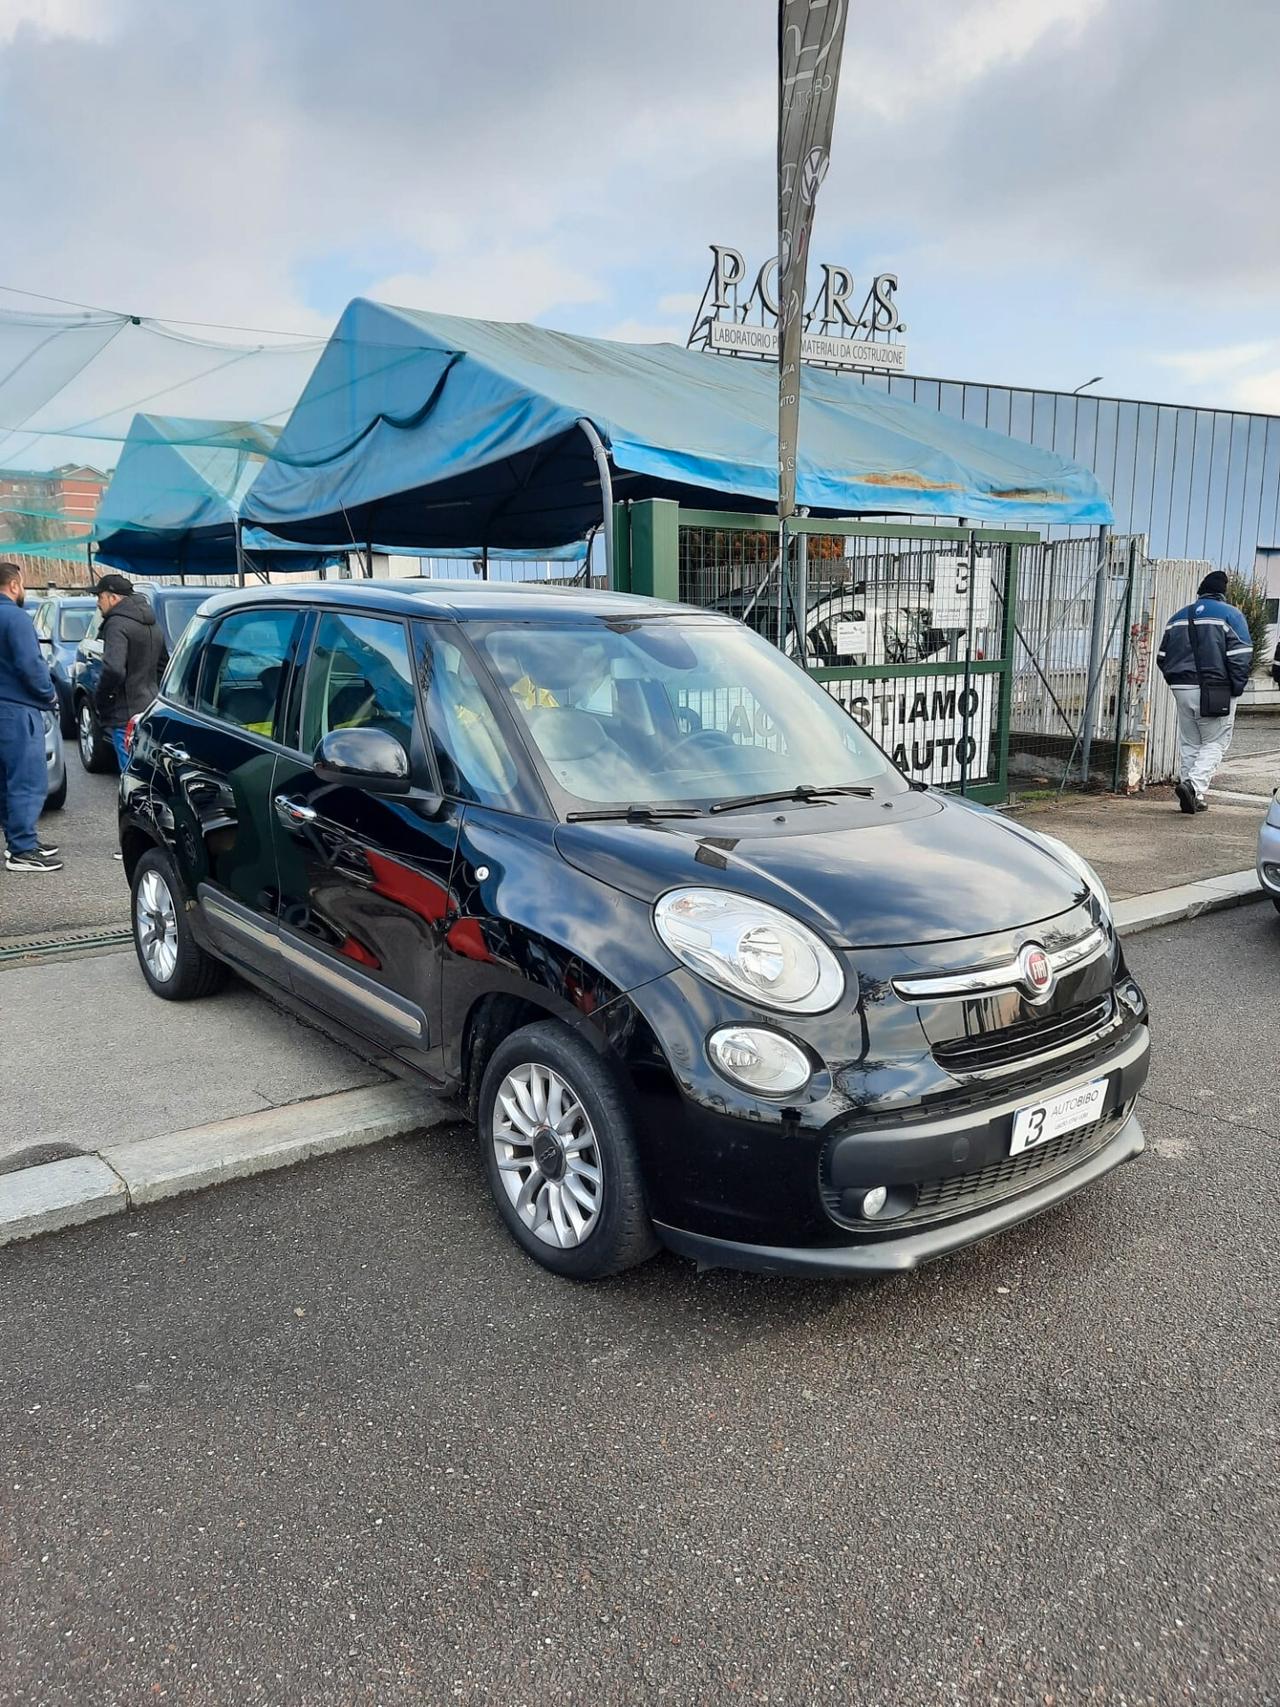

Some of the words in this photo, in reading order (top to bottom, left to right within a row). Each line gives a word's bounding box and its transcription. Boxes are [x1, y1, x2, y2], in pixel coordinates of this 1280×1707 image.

[714, 327, 771, 348] LABORATORIO
[840, 344, 852, 358] DA
[852, 345, 903, 365] COSTRUZIONE
[1052, 1090, 1099, 1116] AUTOBIBO
